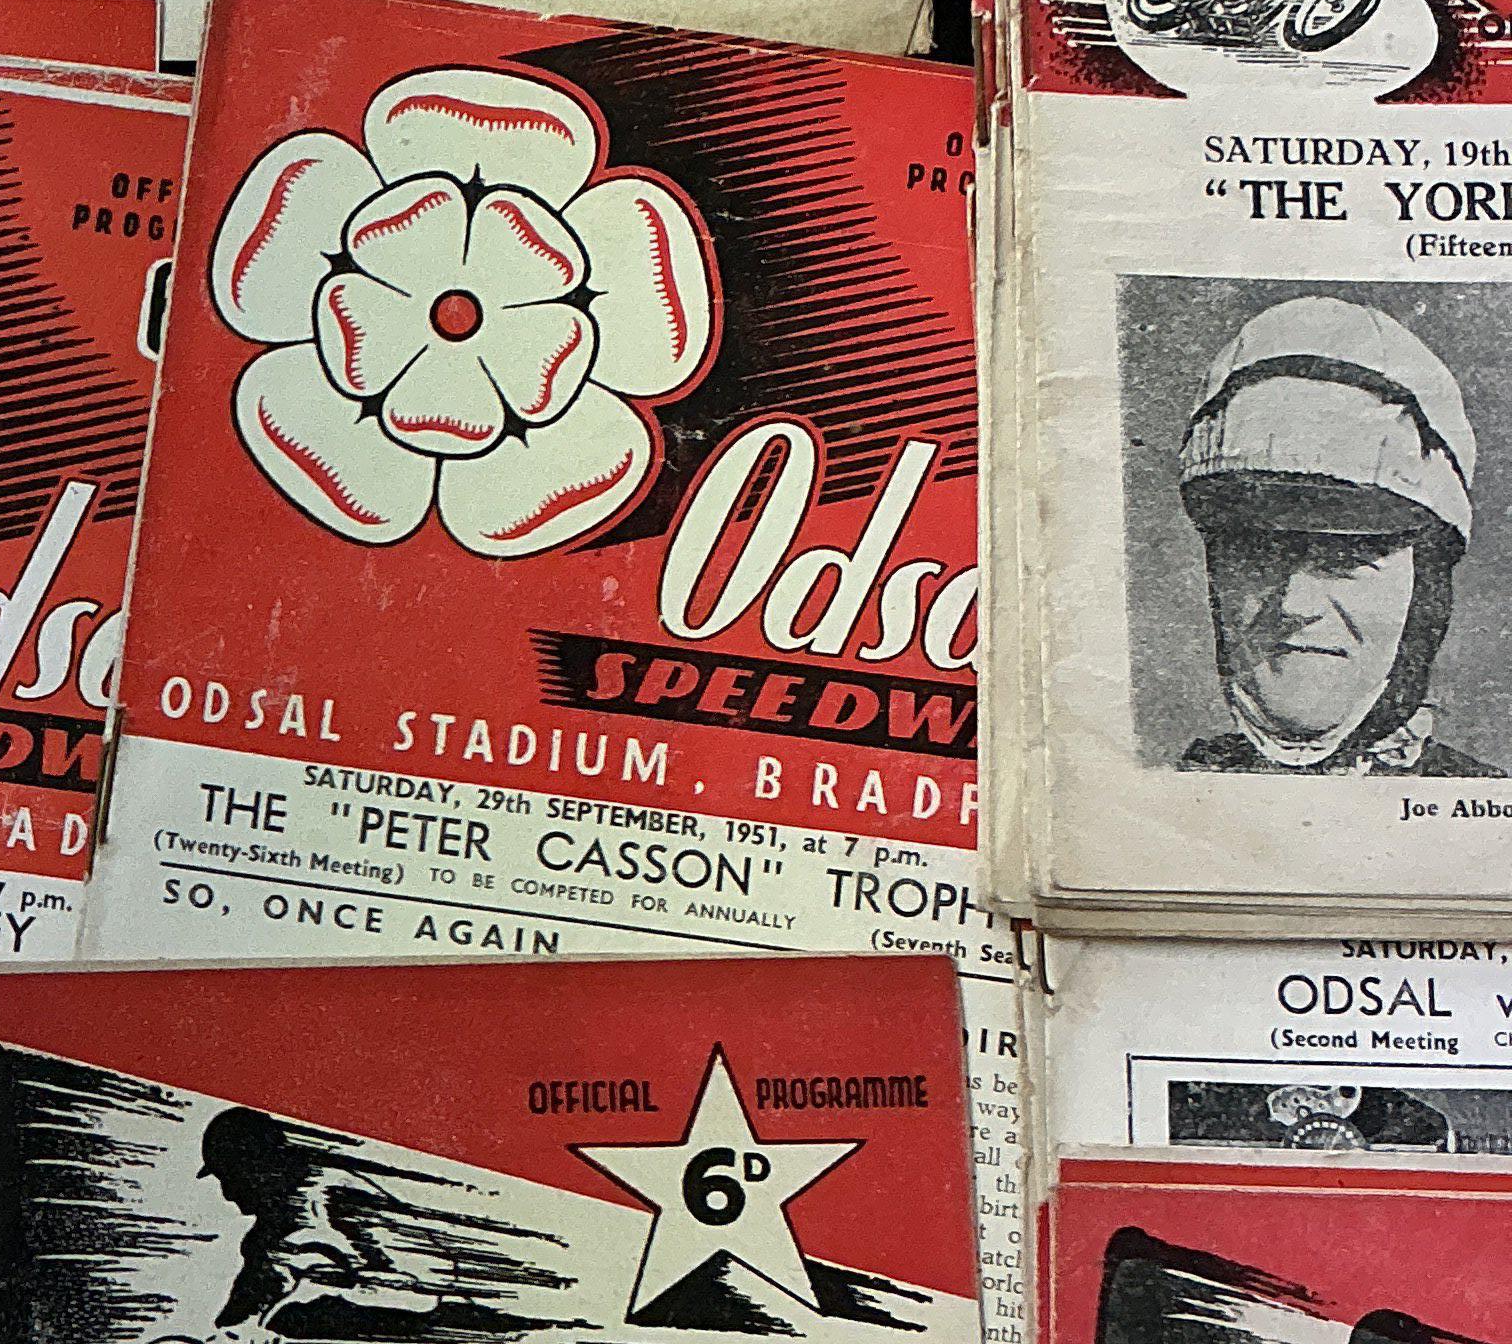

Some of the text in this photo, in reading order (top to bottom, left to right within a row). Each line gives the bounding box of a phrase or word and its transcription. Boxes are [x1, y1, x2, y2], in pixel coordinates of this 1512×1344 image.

[1204, 135, 1431, 170] SATURDAY,
[161, 676, 341, 743] ODSAL
[200, 782, 288, 834] THE
[304, 766, 928, 868] SATURDAY, 29th SEPTEMBER, 1951, p.m.
[1400, 798, 1439, 821] Joe
[153, 829, 797, 931] (Twenty-Sixth Meeting) COMPETED ANNUALLY
[20, 890, 73, 912] p.m.
[162, 878, 560, 955] SO, ONCE AGAIN
[1277, 974, 1453, 1018] ODSAL
[1270, 1028, 1460, 1054] (Second Meeting
[528, 1079, 659, 1115] OFFICIAL
[755, 1075, 929, 1111] PROGRAMME
